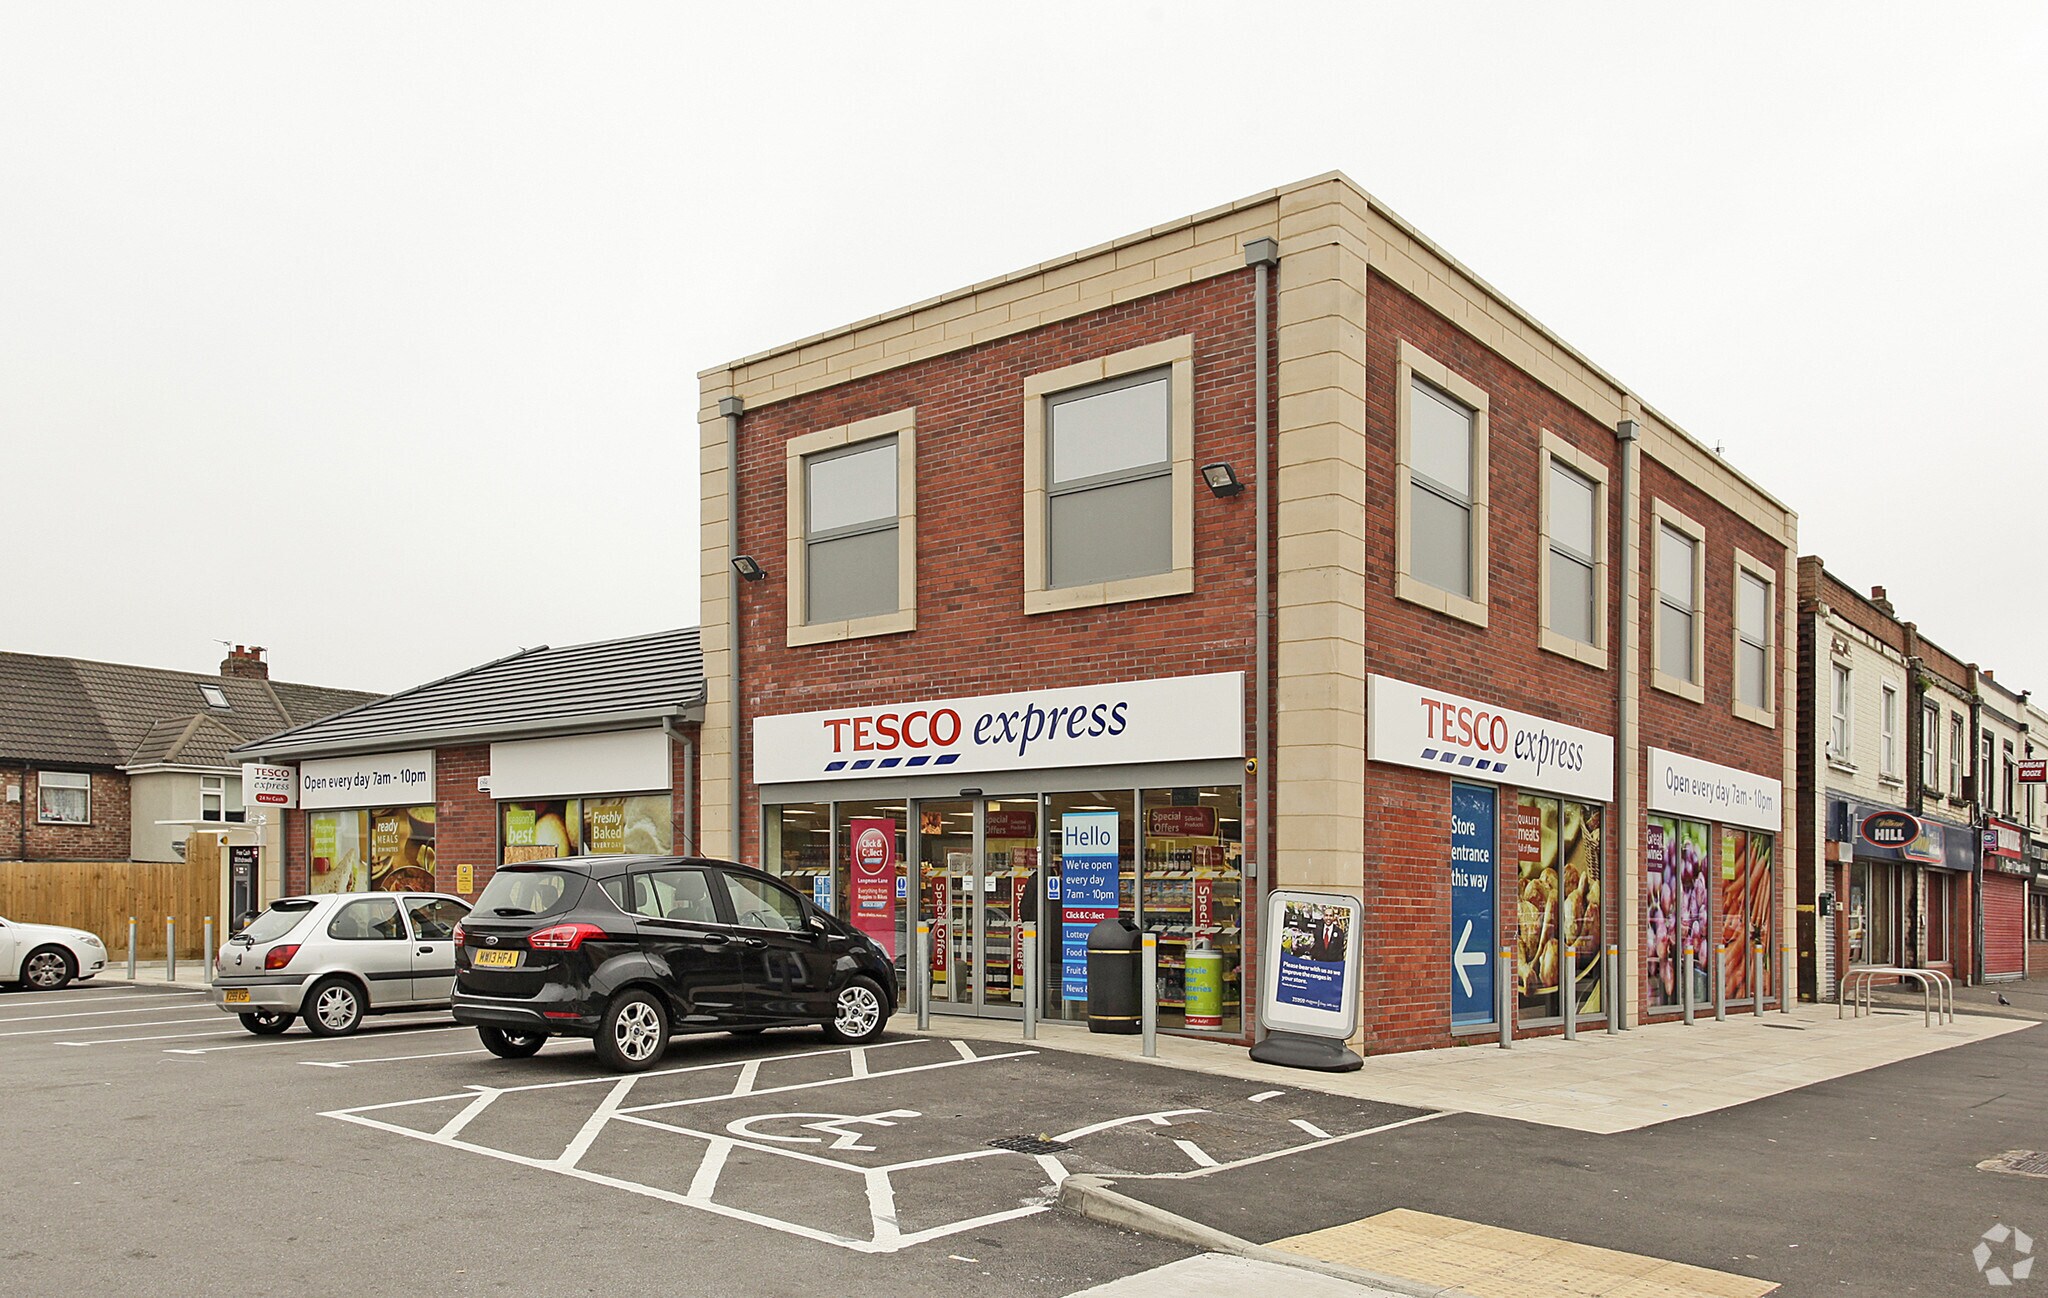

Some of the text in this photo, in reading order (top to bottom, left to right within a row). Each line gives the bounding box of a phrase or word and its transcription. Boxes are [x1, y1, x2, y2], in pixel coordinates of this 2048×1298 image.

[824, 702, 1128, 756] TESCO express
[1421, 697, 1583, 776] TESCO express
[254, 768, 290, 777] TESCO
[304, 775, 327, 792] Open
[329, 777, 352, 790] every
[354, 772, 370, 789] day
[373, 771, 391, 786] 7am
[400, 768, 426, 786] 10pm
[254, 782, 290, 791] express
[1666, 766, 1690, 796] Open
[1692, 779, 1715, 803] every
[1716, 779, 1730, 807] day
[1732, 784, 1748, 805] 7am
[1754, 789, 1773, 813] 10pm
[508, 813, 534, 824] season's
[593, 811, 622, 825] Freshly
[986, 815, 1008, 824] pecial
[1152, 811, 1181, 822] Special
[1518, 814, 1539, 826] QUALITY
[377, 819, 398, 834] ready
[1154, 823, 1180, 832] Offers
[1451, 814, 1475, 836] Store
[508, 826, 534, 845] best
[593, 826, 622, 839] Baked
[1065, 825, 1111, 846] Hello
[1518, 827, 1539, 842] meats
[1874, 828, 1905, 841] HILL
[377, 835, 398, 844] MEALS
[862, 839, 876, 848] Click
[1451, 844, 1489, 862] entrance
[1065, 860, 1112, 871] We're open
[1065, 874, 1105, 886] every day
[1451, 868, 1488, 892] this way
[1066, 889, 1084, 899] 7am
[1092, 889, 1114, 901] 10pm
[934, 883, 945, 926] Special
[1197, 886, 1210, 935] Special
[1066, 931, 1089, 941] Lottery
[936, 928, 945, 966] Offers
[1066, 948, 1083, 957] Food
[1066, 966, 1081, 975] Fruit
[1282, 961, 1299, 969] Please
[1299, 963, 1310, 971] bear
[1310, 973, 1327, 981] ranges
[1066, 984, 1083, 993] News
